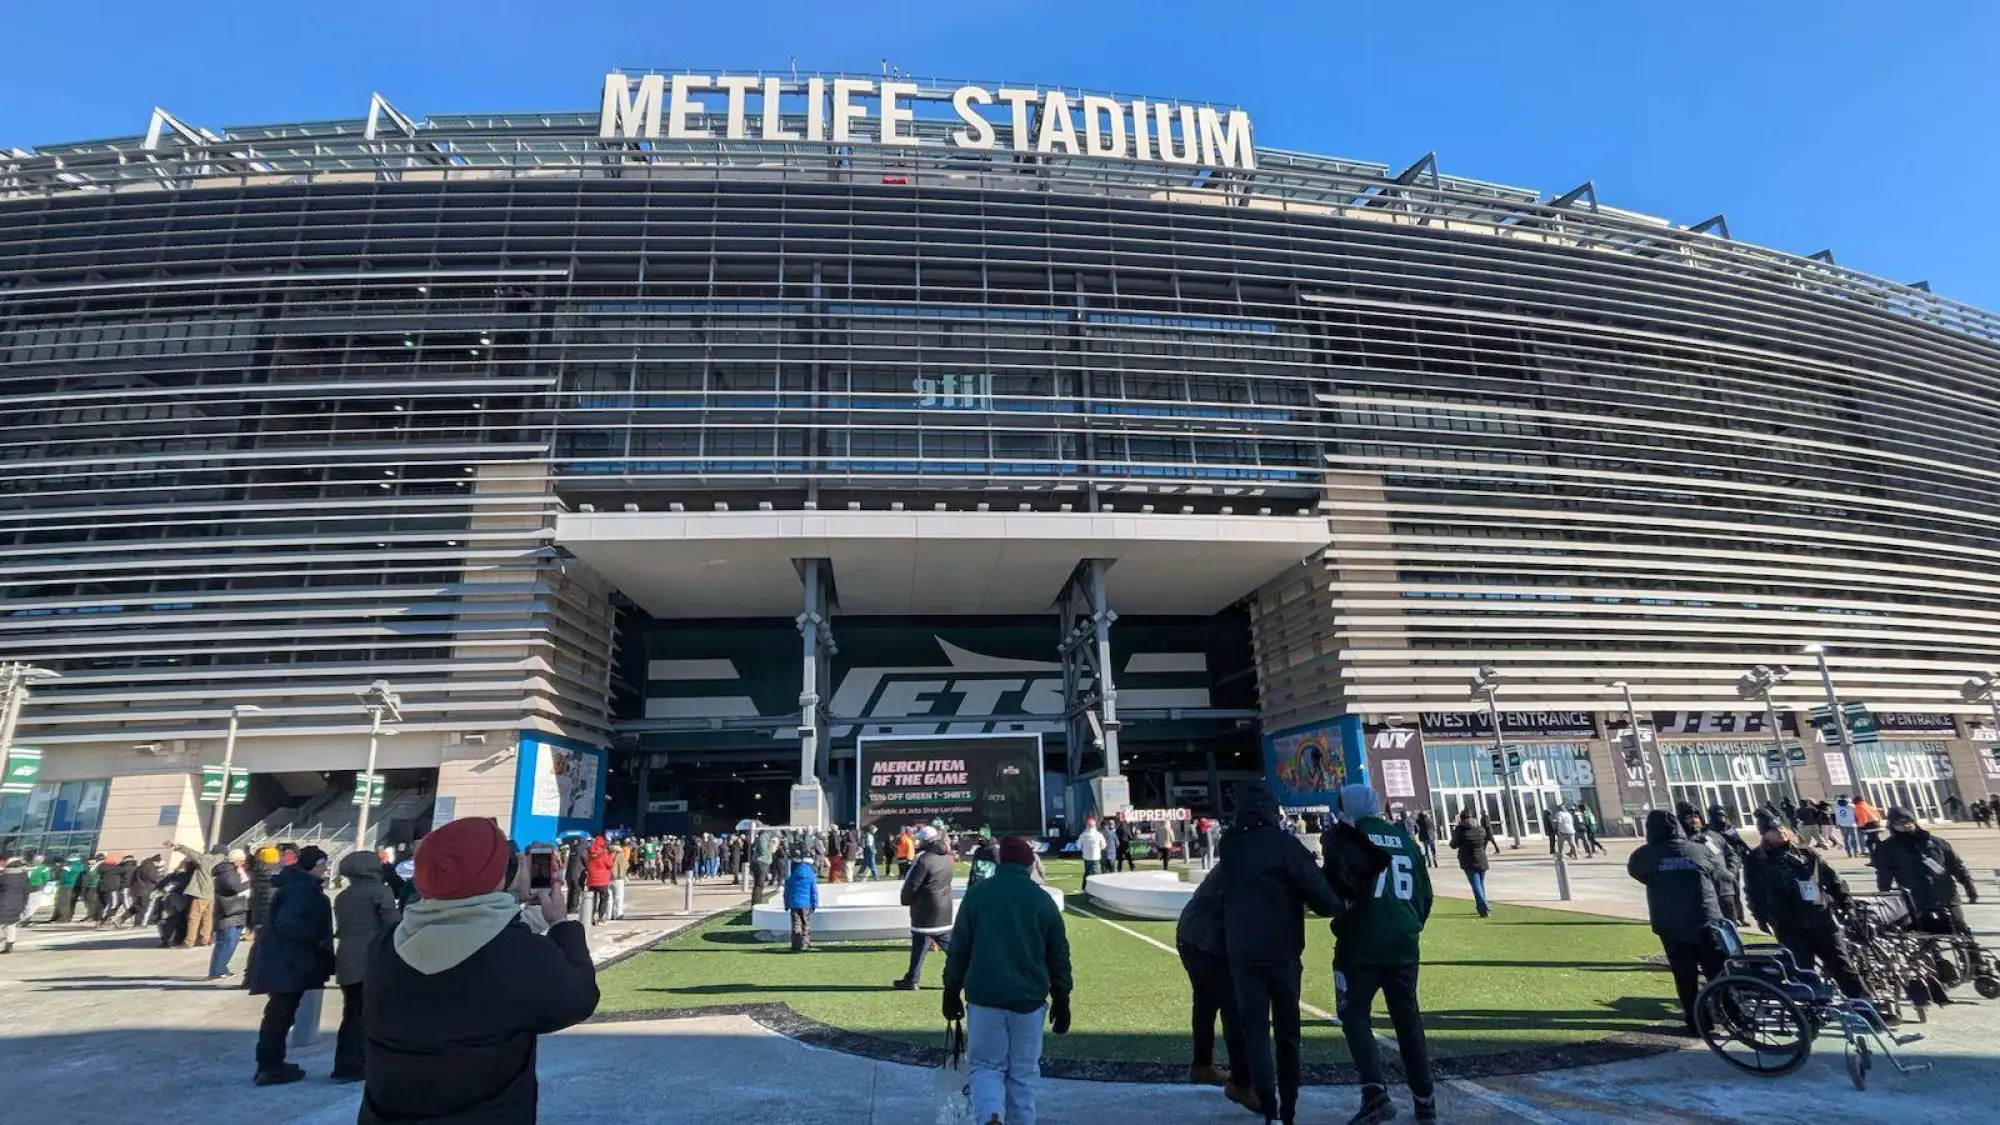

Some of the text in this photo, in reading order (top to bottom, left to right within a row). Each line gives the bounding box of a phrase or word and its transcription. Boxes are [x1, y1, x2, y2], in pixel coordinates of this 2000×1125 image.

[600, 73, 1256, 170] METLIFE STADIUM
[1423, 711, 1590, 727] WEST VIP ENTRANCE
[1878, 714, 1895, 725] VIP
[1899, 713, 1953, 727] ENTRANCE
[872, 759, 966, 774] MERCH ITEM
[1521, 759, 1595, 786] CLUB
[1886, 752, 1954, 779] SUITES
[870, 772, 969, 787] OF THE GAME
[905, 792, 932, 800] GREEN
[932, 790, 971, 799] T-SHIRTS
